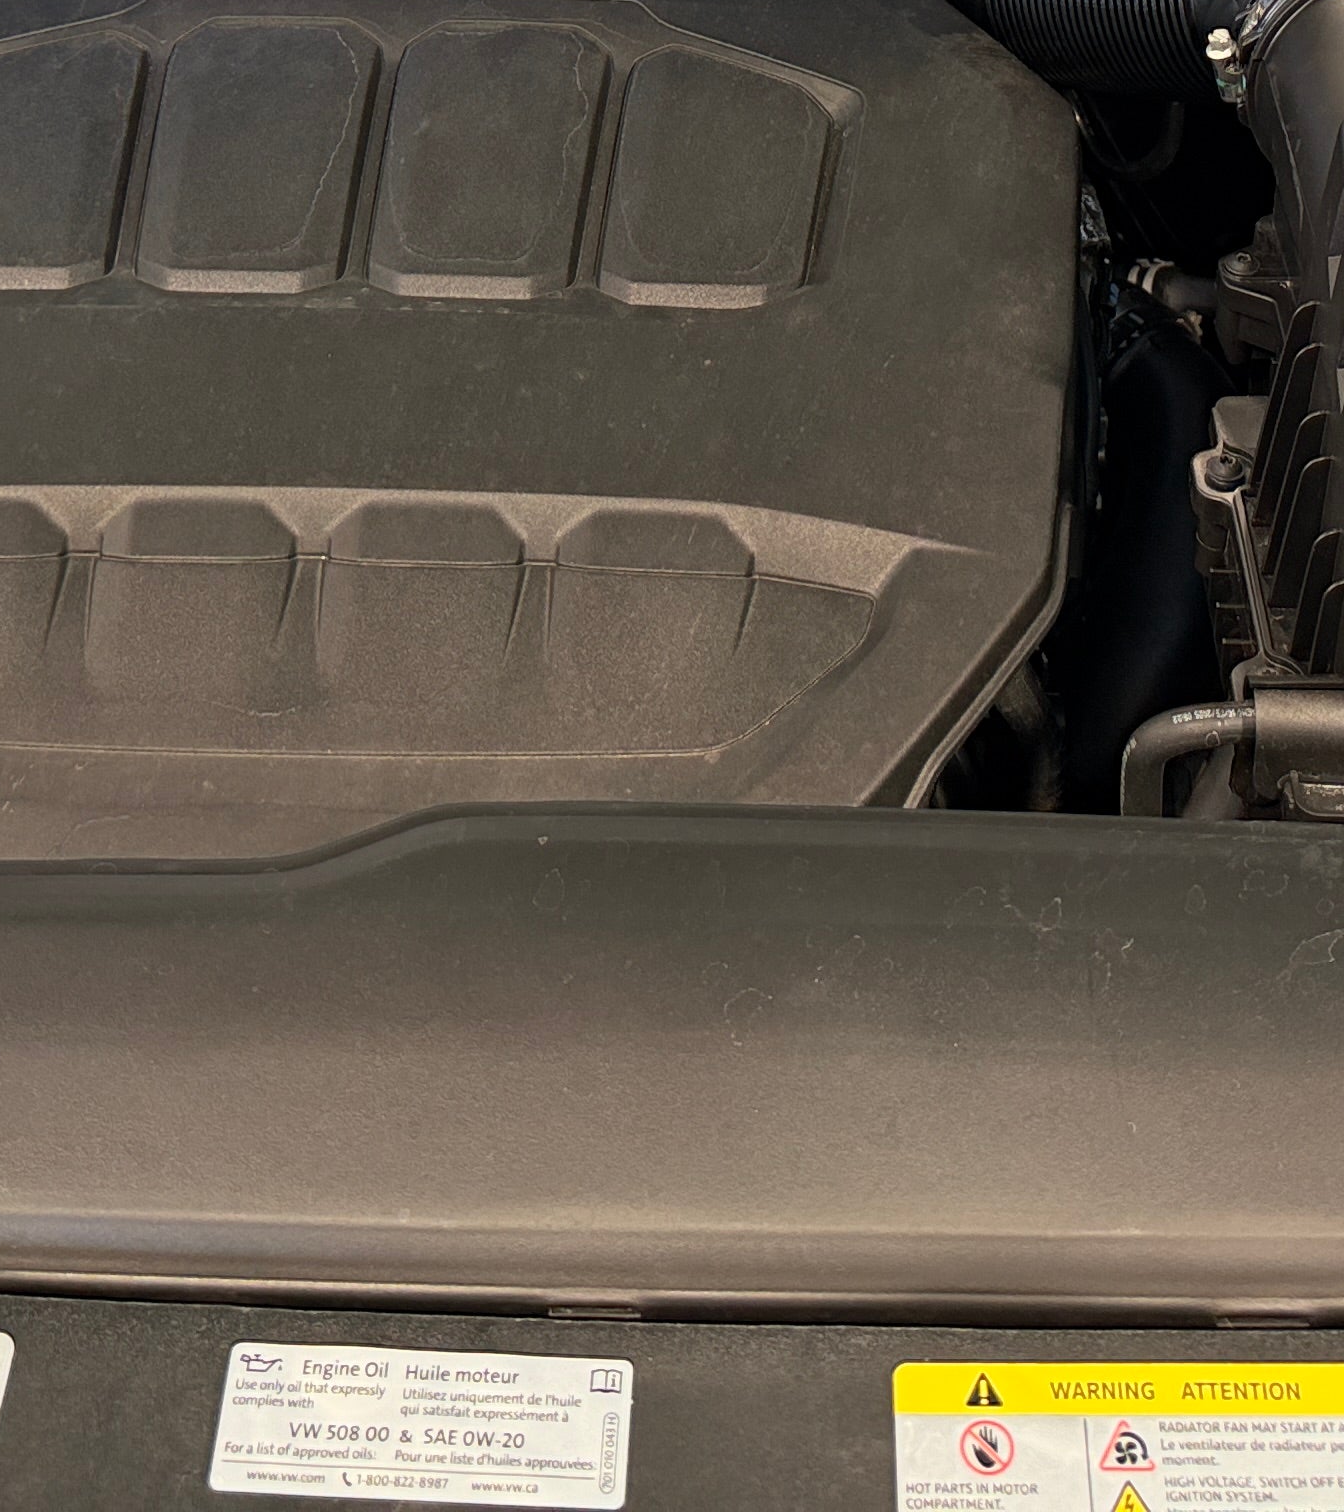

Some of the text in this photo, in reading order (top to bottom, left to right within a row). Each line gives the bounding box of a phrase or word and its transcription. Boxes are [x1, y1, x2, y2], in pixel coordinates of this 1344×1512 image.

[302, 1359, 390, 1380] Engine Oil
[405, 1363, 521, 1385] Huile moteur
[235, 1377, 387, 1400] Use only oil that expressly
[402, 1387, 583, 1408] Utilisez uniquement de l'huile
[1049, 1381, 1302, 1402] WARNING ATTENTION
[231, 1394, 315, 1409] complies with
[399, 1403, 570, 1423] qui satisfait expressément à
[289, 1422, 526, 1449] VW 508 00 & SAE 0W-20
[1159, 1420, 1221, 1434] RADIATOR
[1223, 1421, 1249, 1434] FAN
[1251, 1421, 1277, 1433] MAY
[1280, 1421, 1318, 1434] START
[1320, 1421, 1335, 1433] AT
[224, 1441, 245, 1455] For
[245, 1444, 254, 1455] a
[256, 1442, 275, 1456] list
[276, 1443, 292, 1457] of
[292, 1445, 351, 1460] approved
[1160, 1438, 1176, 1452] Le
[1178, 1438, 1247, 1452] ventilateur
[1250, 1439, 1267, 1452] de
[1269, 1439, 1327, 1453] radiateur
[394, 1449, 423, 1463] Pour
[424, 1452, 448, 1465] une
[449, 1451, 475, 1466] liste
[476, 1452, 523, 1468] d'huiles
[246, 1470, 540, 1494] www.vw.com 1-800-822-8987 www.vw.ca
[905, 1482, 1040, 1495] HOT PARTS IN MOTOR
[1164, 1475, 1196, 1489] HIGH
[1258, 1475, 1309, 1489] SWITCH
[1309, 1476, 1335, 1489] OFF
[1165, 1490, 1223, 1503] IGNITION
